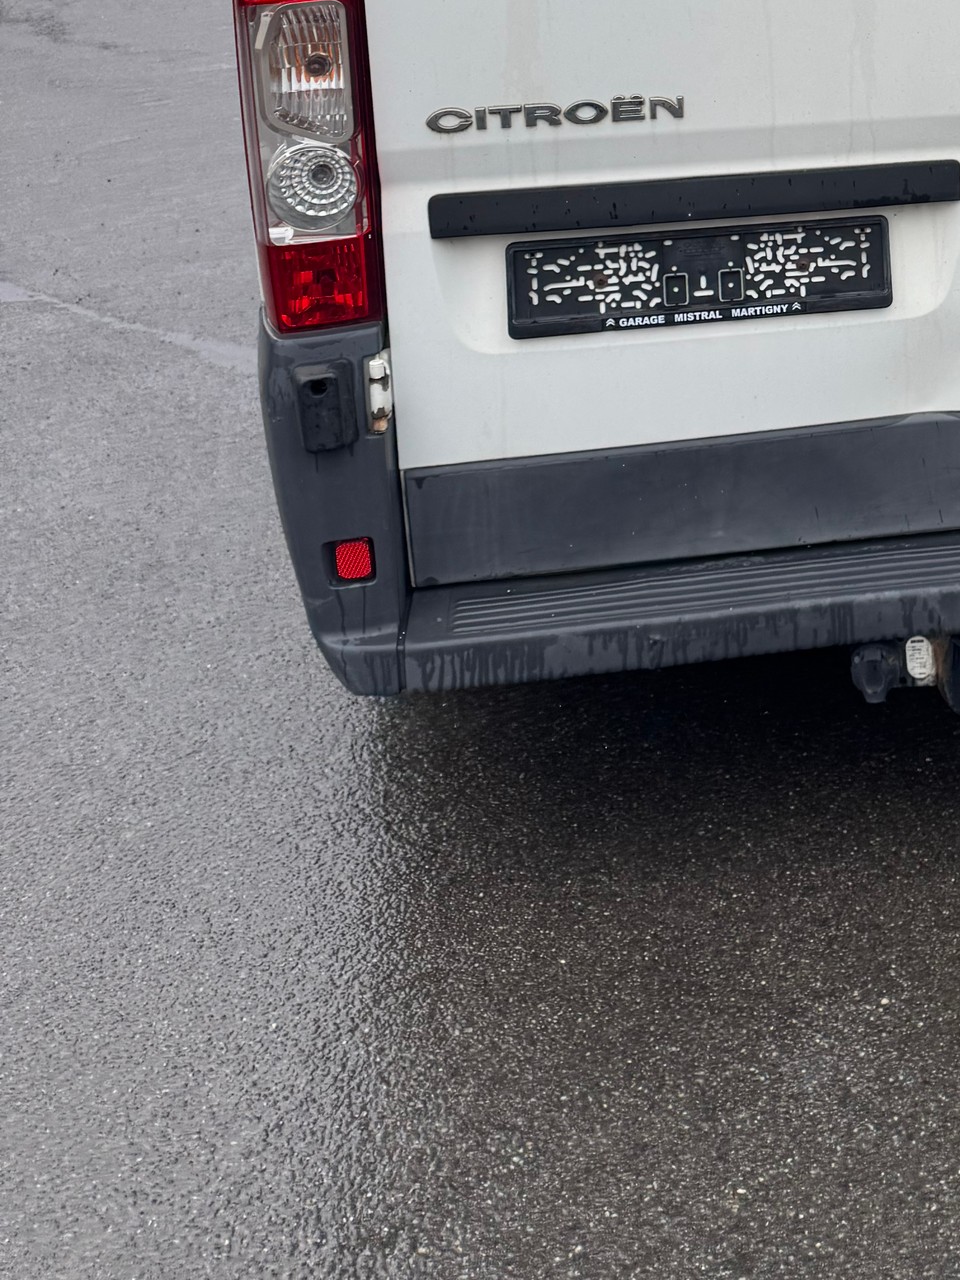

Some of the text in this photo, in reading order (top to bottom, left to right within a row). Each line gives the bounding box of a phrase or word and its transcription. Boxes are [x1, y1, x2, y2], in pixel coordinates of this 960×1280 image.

[426, 94, 684, 134] CITROËN
[619, 304, 789, 327] GARAGE MISTRAL MARTIGNY
